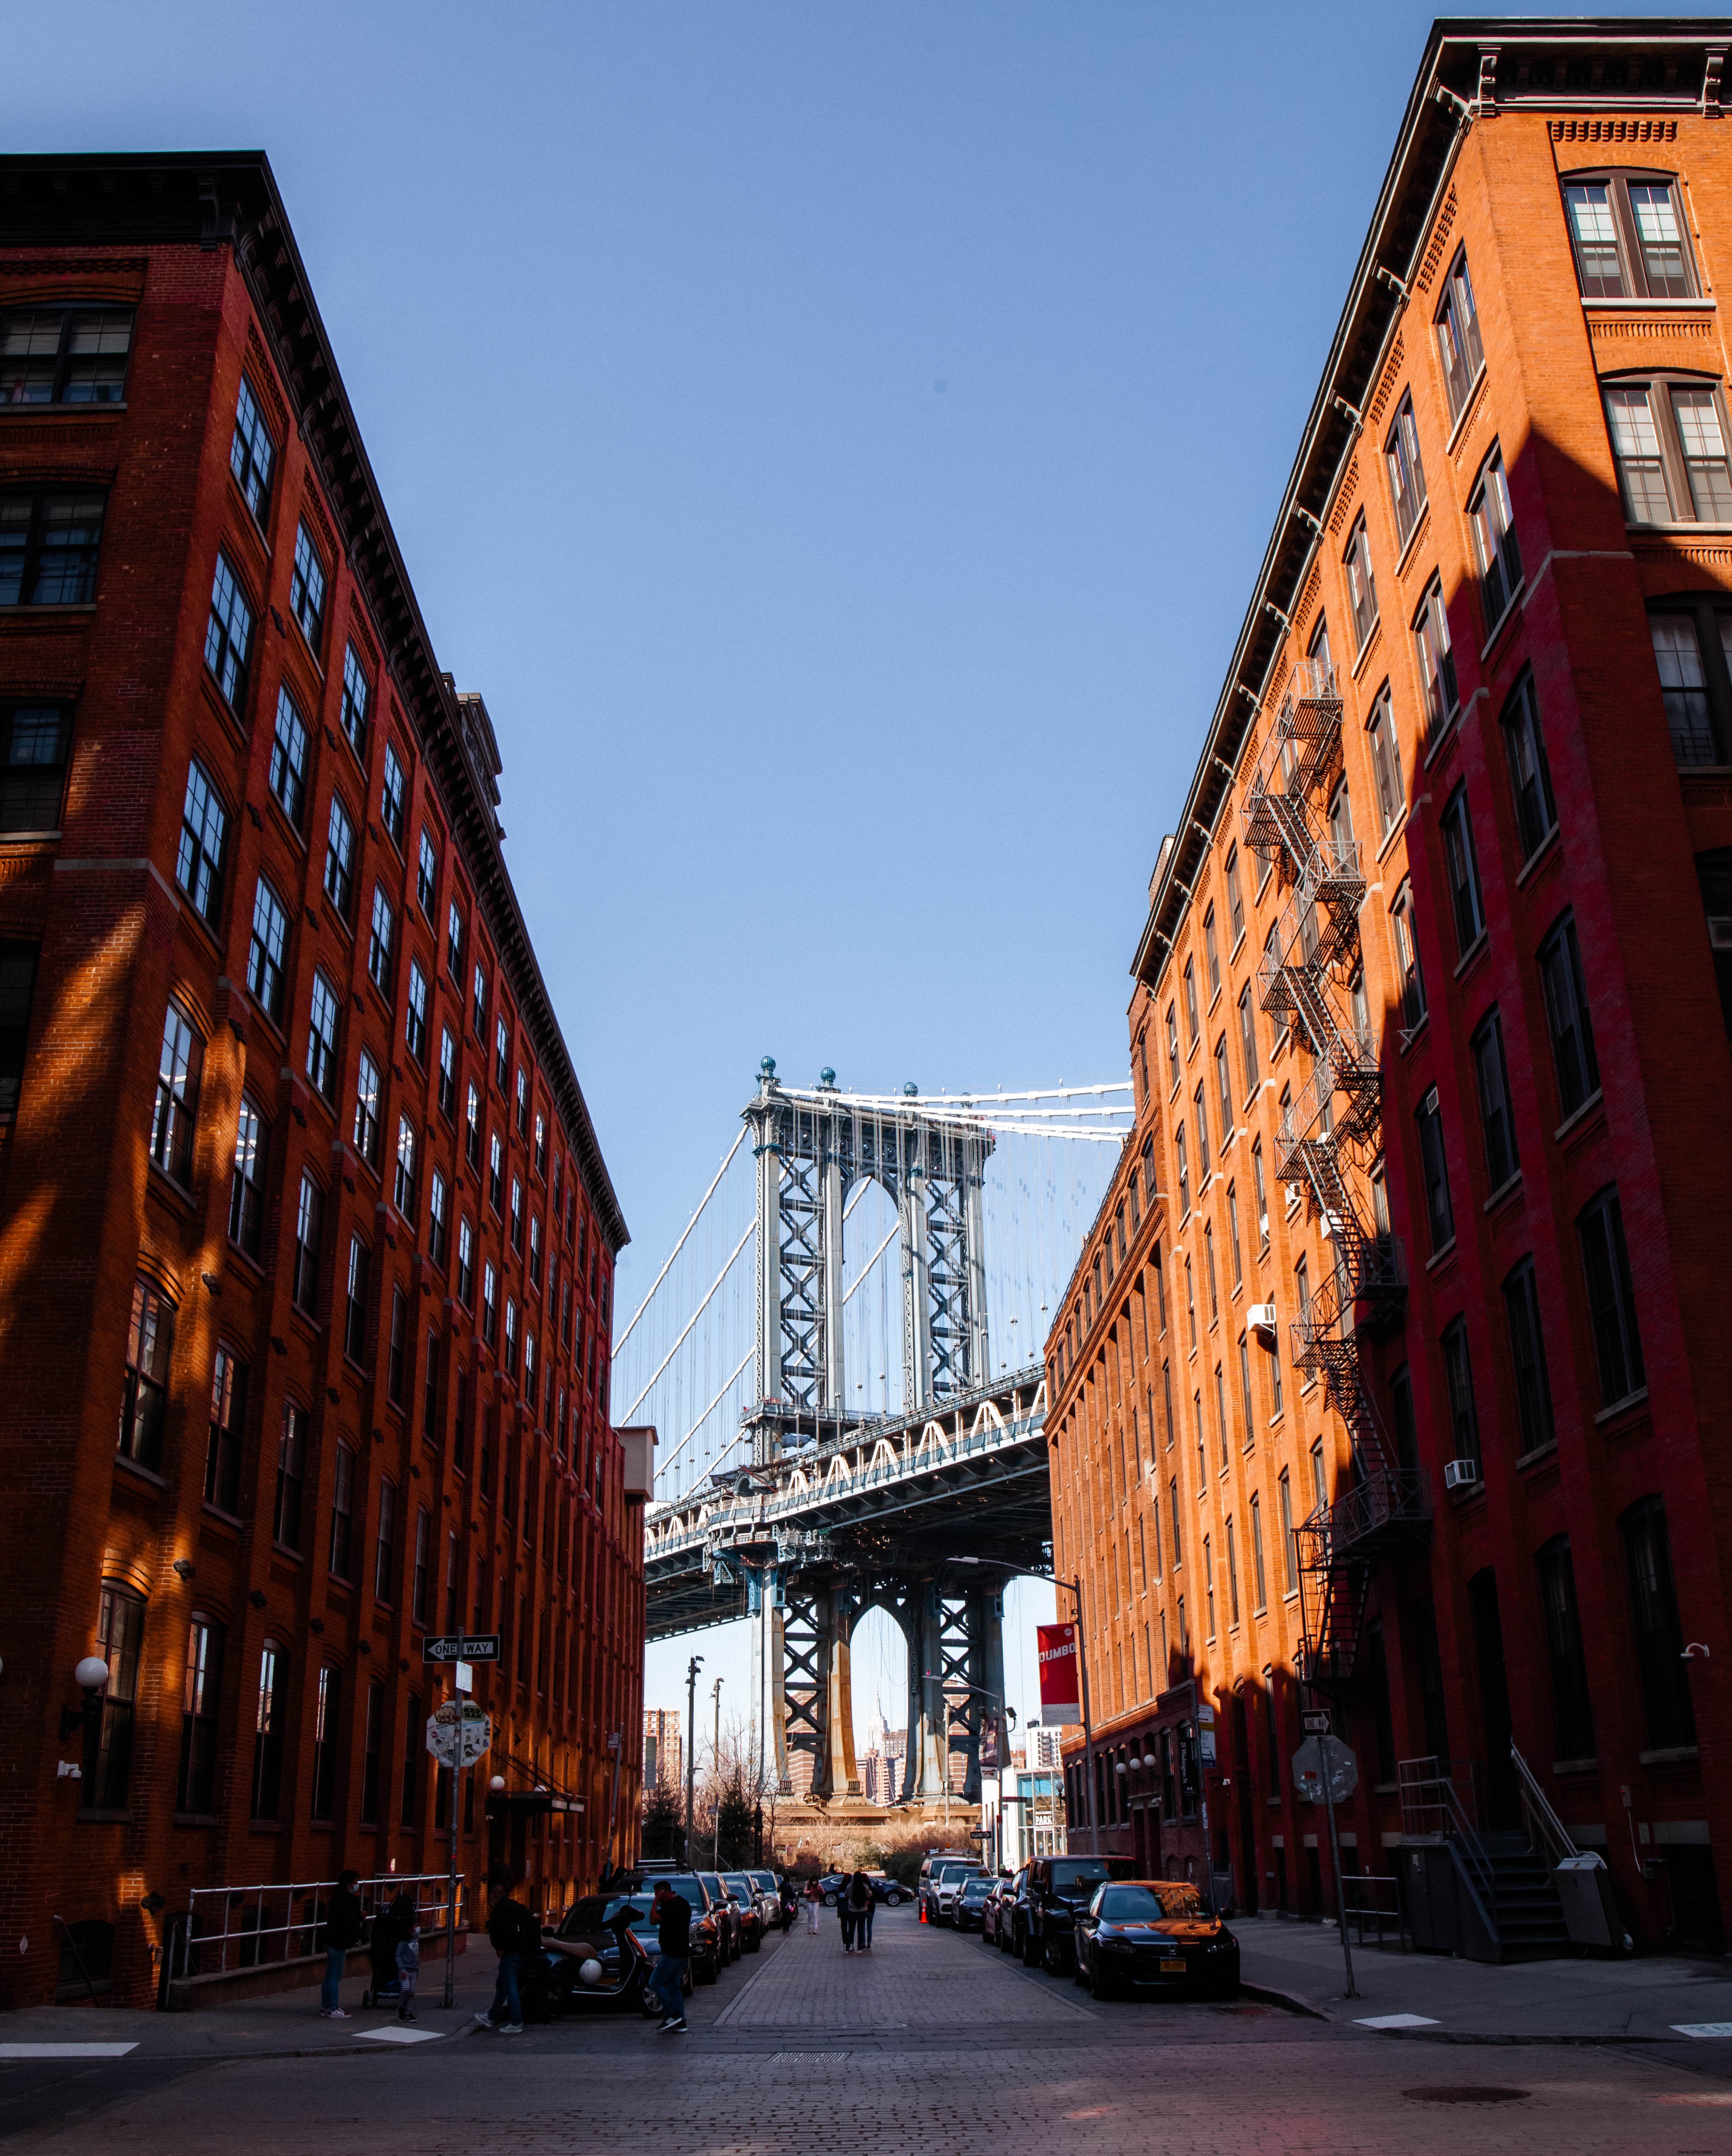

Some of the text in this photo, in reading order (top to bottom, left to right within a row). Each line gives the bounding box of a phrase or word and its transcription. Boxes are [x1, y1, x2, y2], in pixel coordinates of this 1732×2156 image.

[435, 1644, 489, 1655] ONE WAY
[1038, 1642, 1077, 1663] DUMBO
[1306, 1718, 1326, 1728] ONE WAY
[979, 1749, 997, 1760] DUMBO
[1035, 1815, 1053, 1825] PARK
